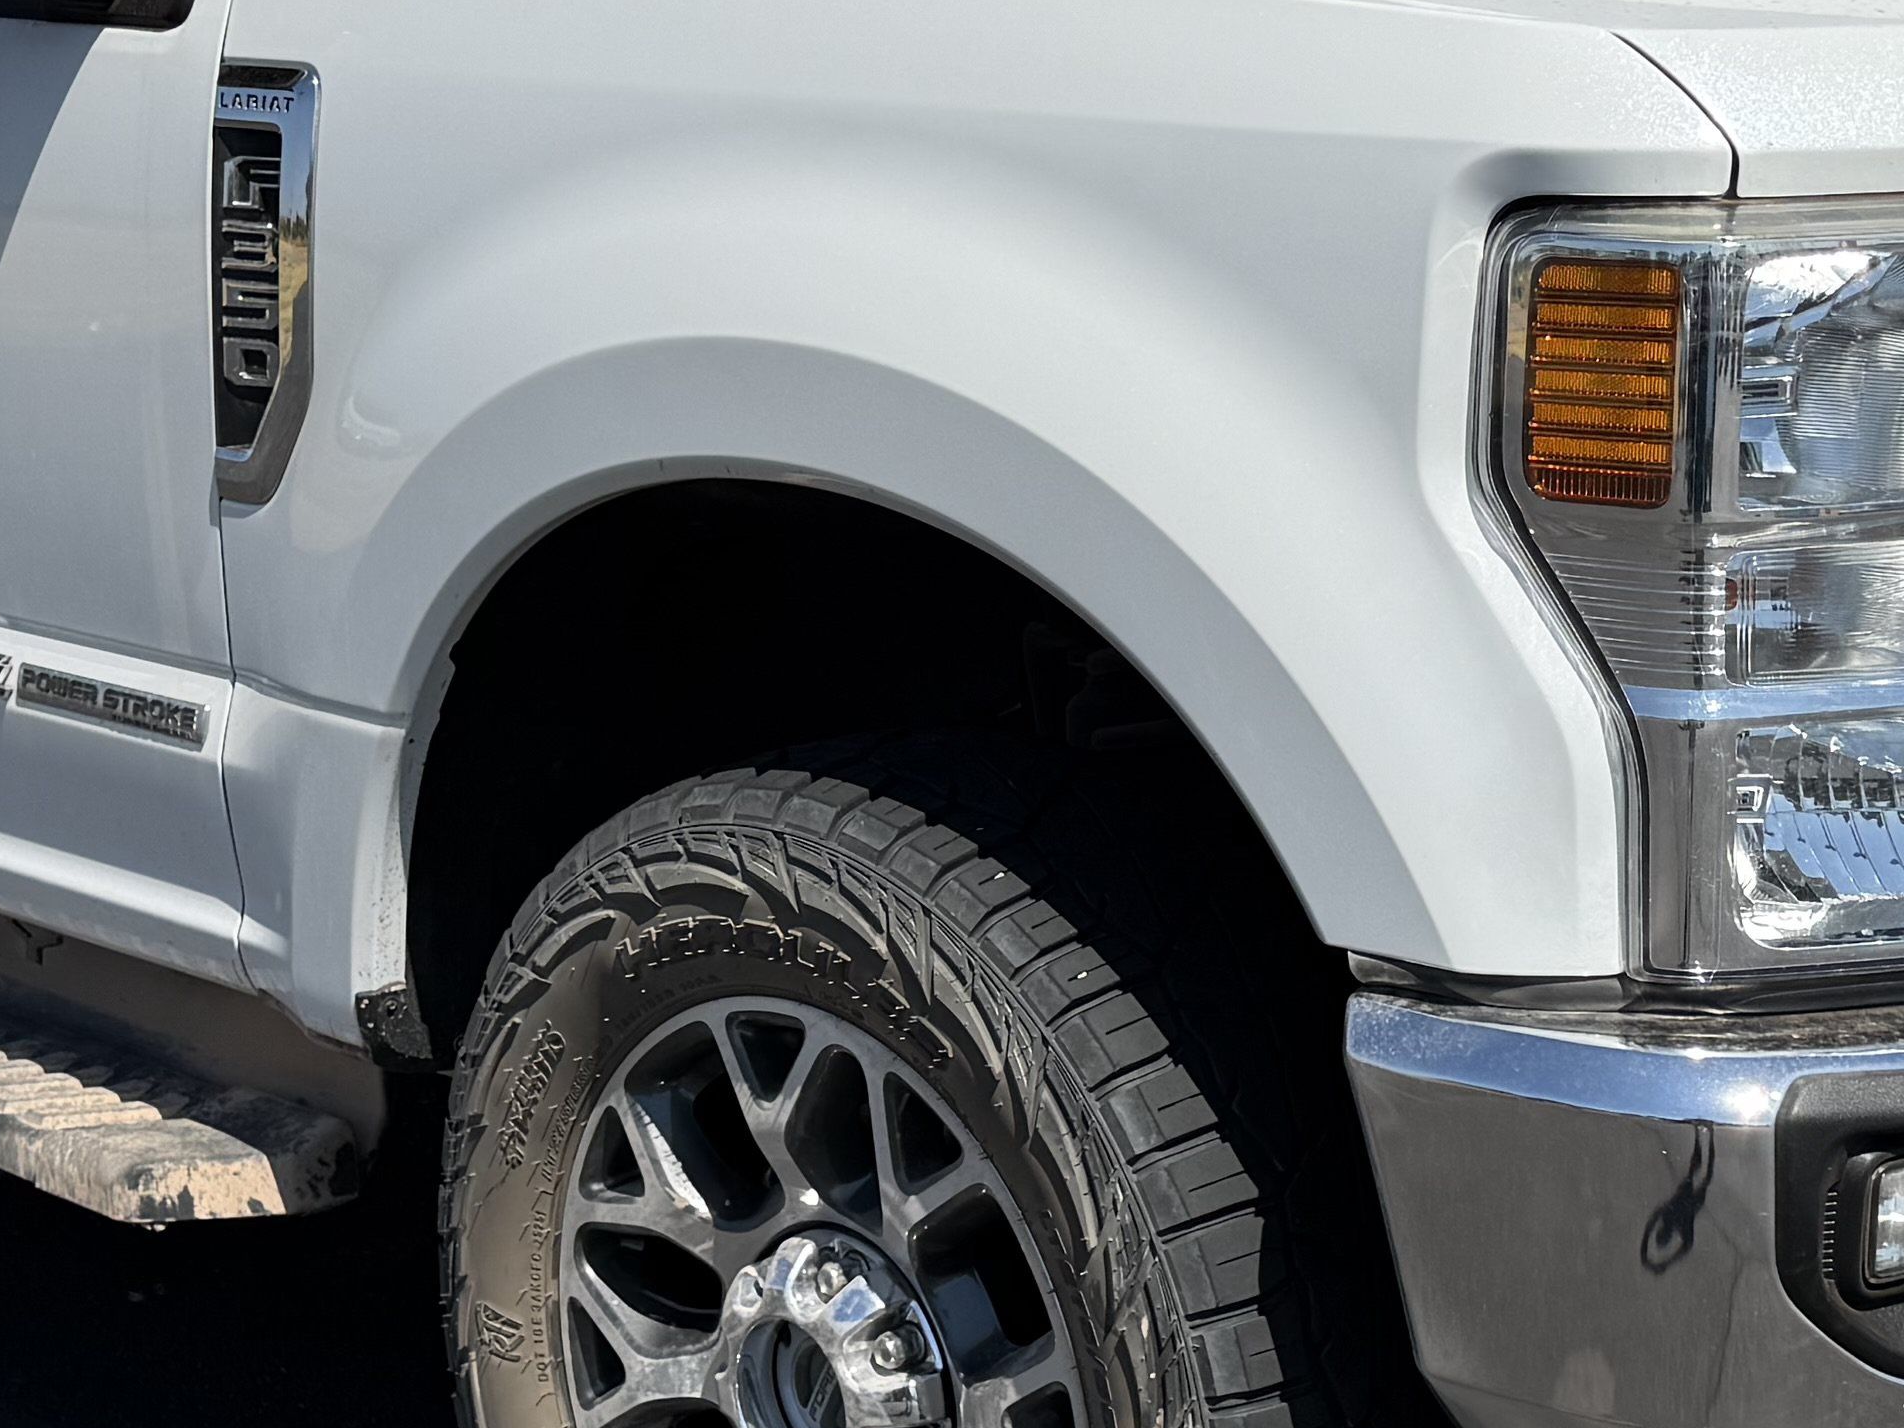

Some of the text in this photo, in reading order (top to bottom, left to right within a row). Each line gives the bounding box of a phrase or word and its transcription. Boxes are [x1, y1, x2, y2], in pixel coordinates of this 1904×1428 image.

[219, 92, 295, 113] LARIAT
[19, 667, 99, 706] POWER
[101, 688, 199, 733] STROKE
